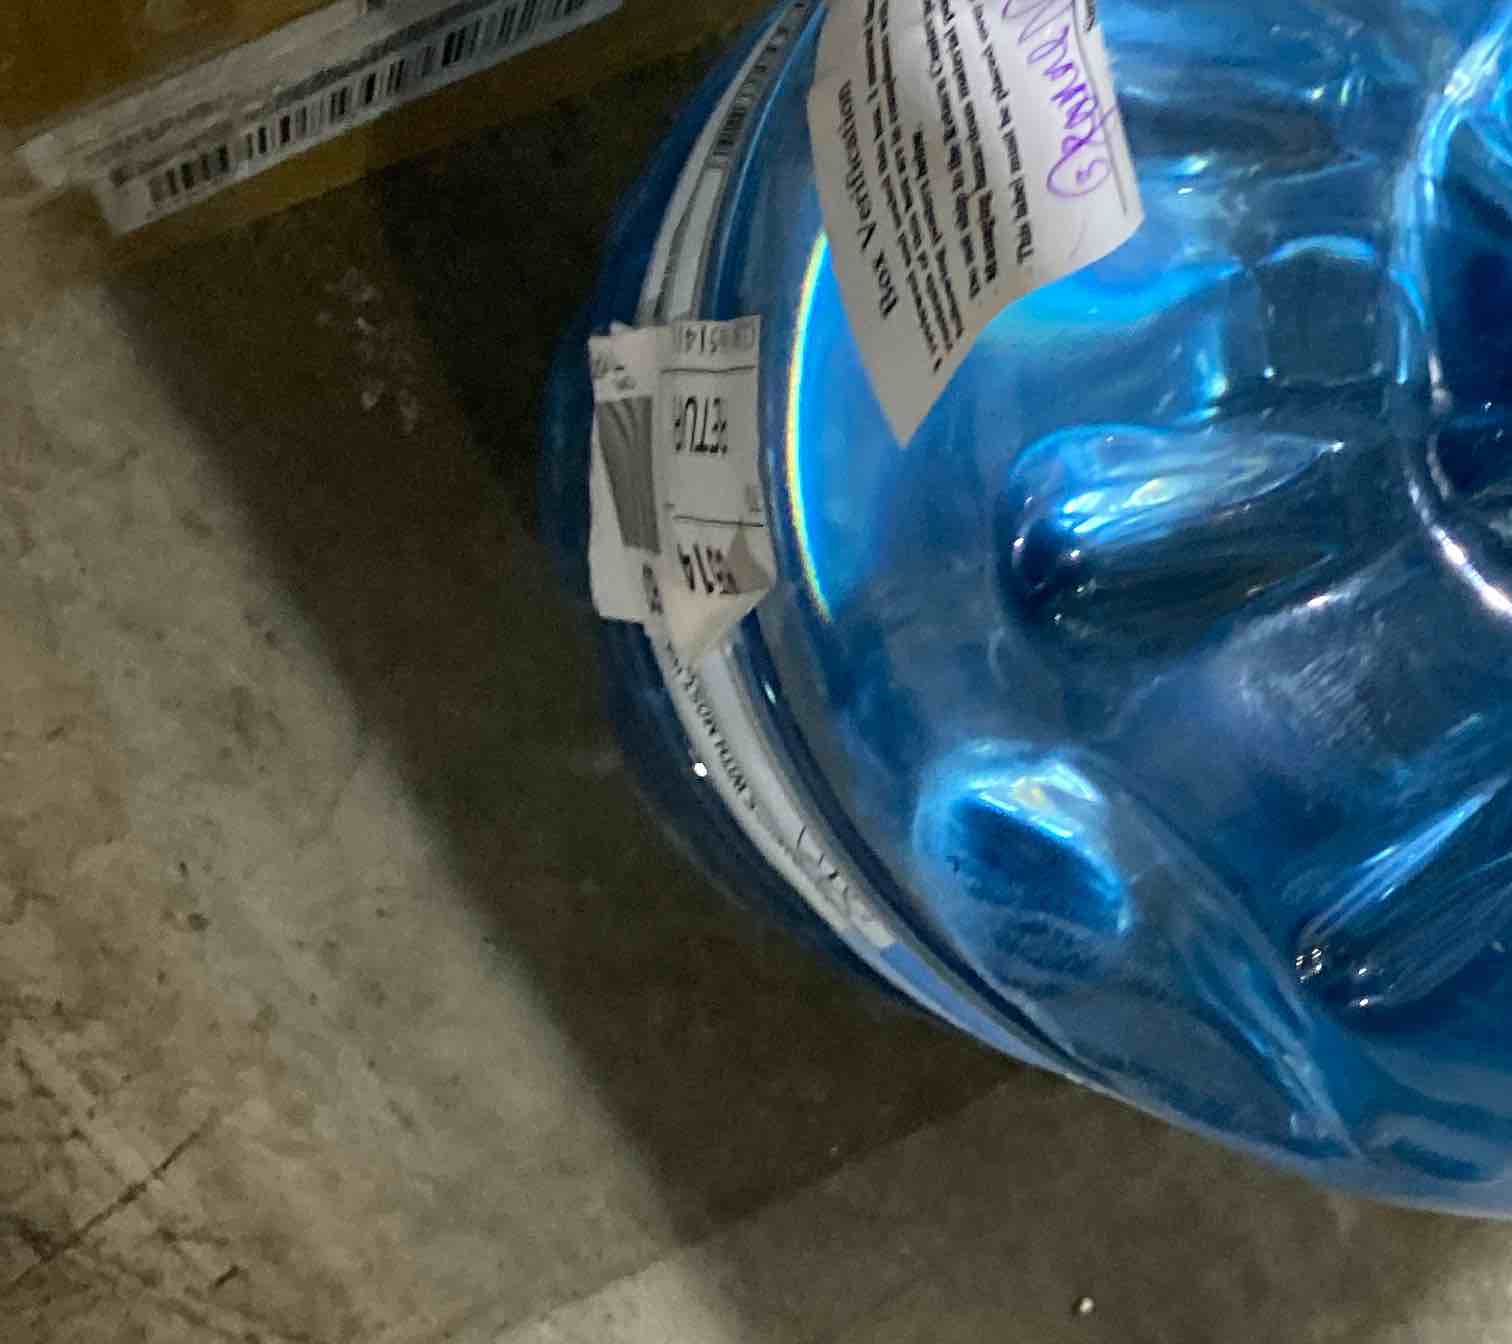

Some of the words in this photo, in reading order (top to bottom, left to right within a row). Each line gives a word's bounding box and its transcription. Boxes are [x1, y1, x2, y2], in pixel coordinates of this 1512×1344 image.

[924, 17, 943, 79] Center
[943, 25, 969, 102] material
[980, 43, 1009, 103] placed
[998, 105, 1011, 129] be
[837, 80, 877, 253] Verification
[1016, 222, 1033, 263] This
[872, 251, 899, 320] Box
